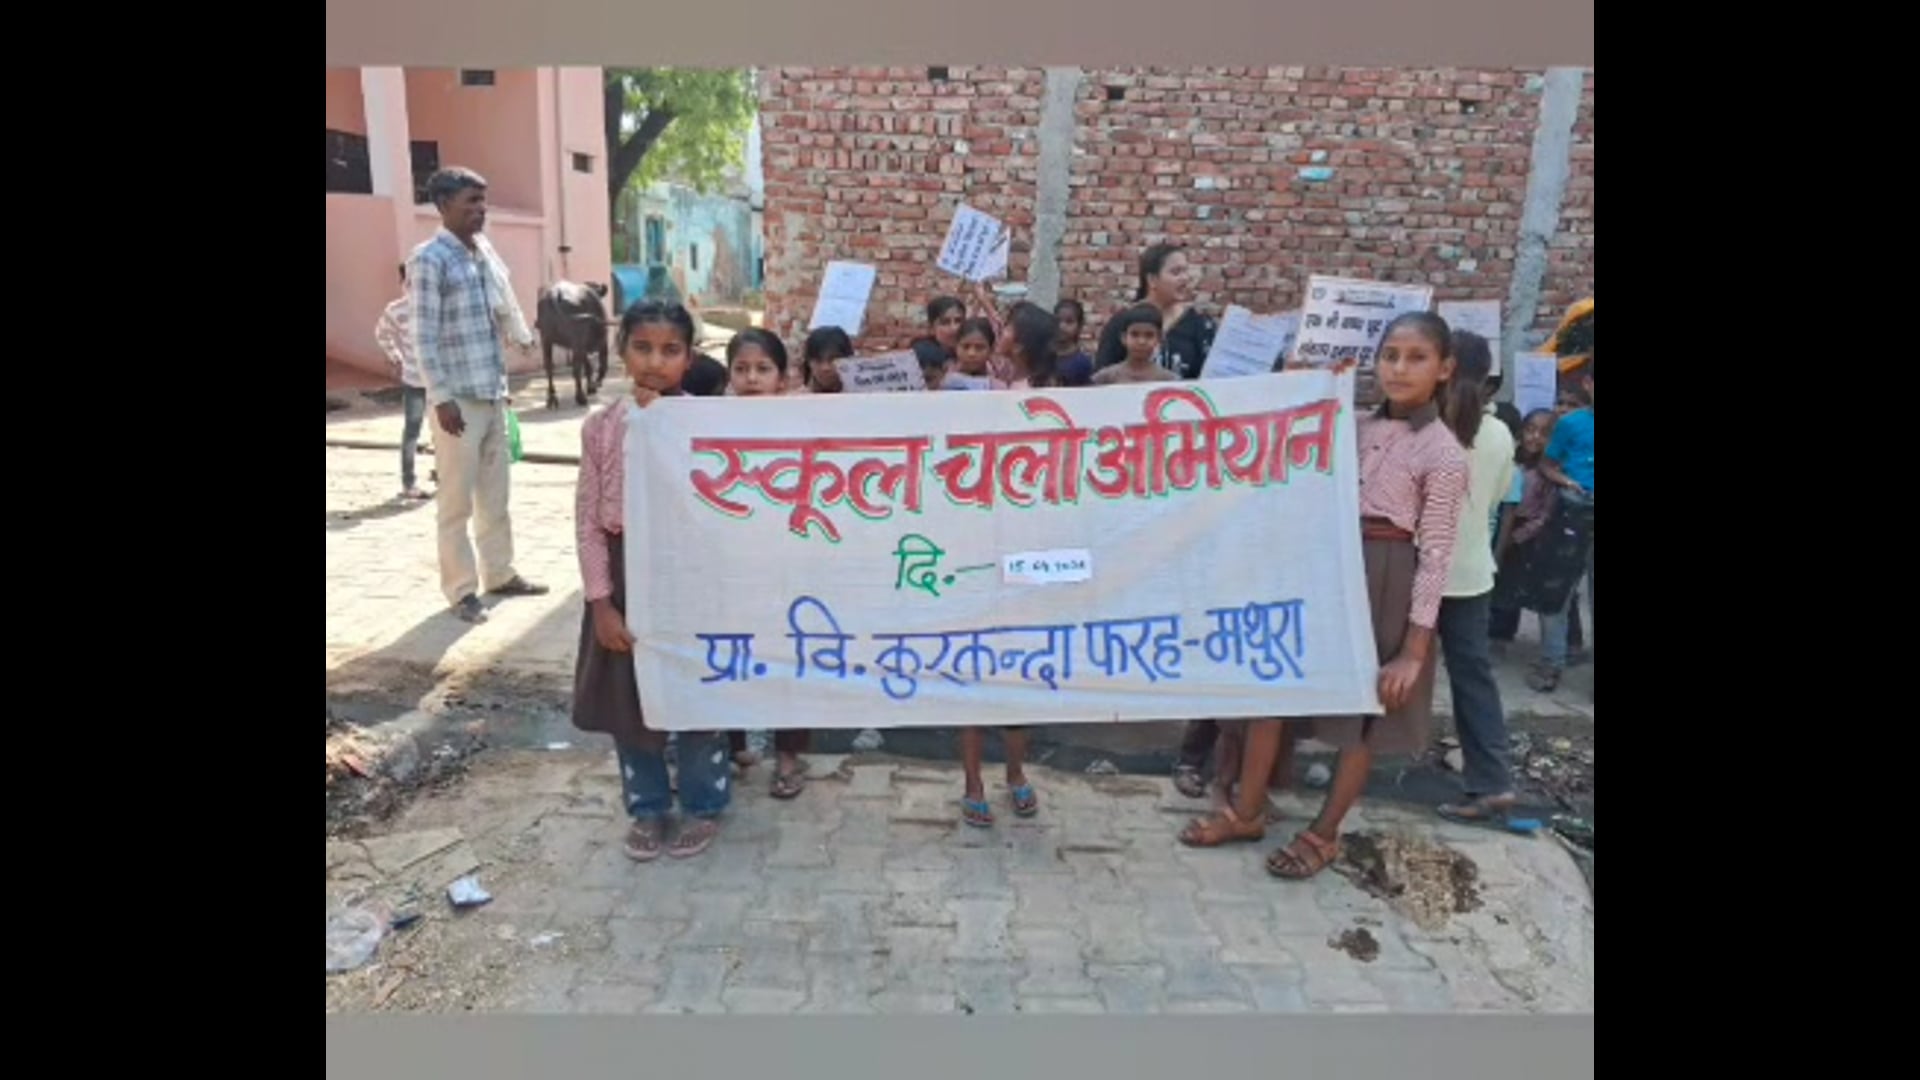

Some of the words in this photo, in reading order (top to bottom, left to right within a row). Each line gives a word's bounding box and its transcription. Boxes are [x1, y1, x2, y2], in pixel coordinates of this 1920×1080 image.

[689, 435, 934, 543] स्कूल
[932, 396, 1091, 510] चलो
[695, 633, 768, 683] प्रा.
[785, 595, 867, 678] वि.
